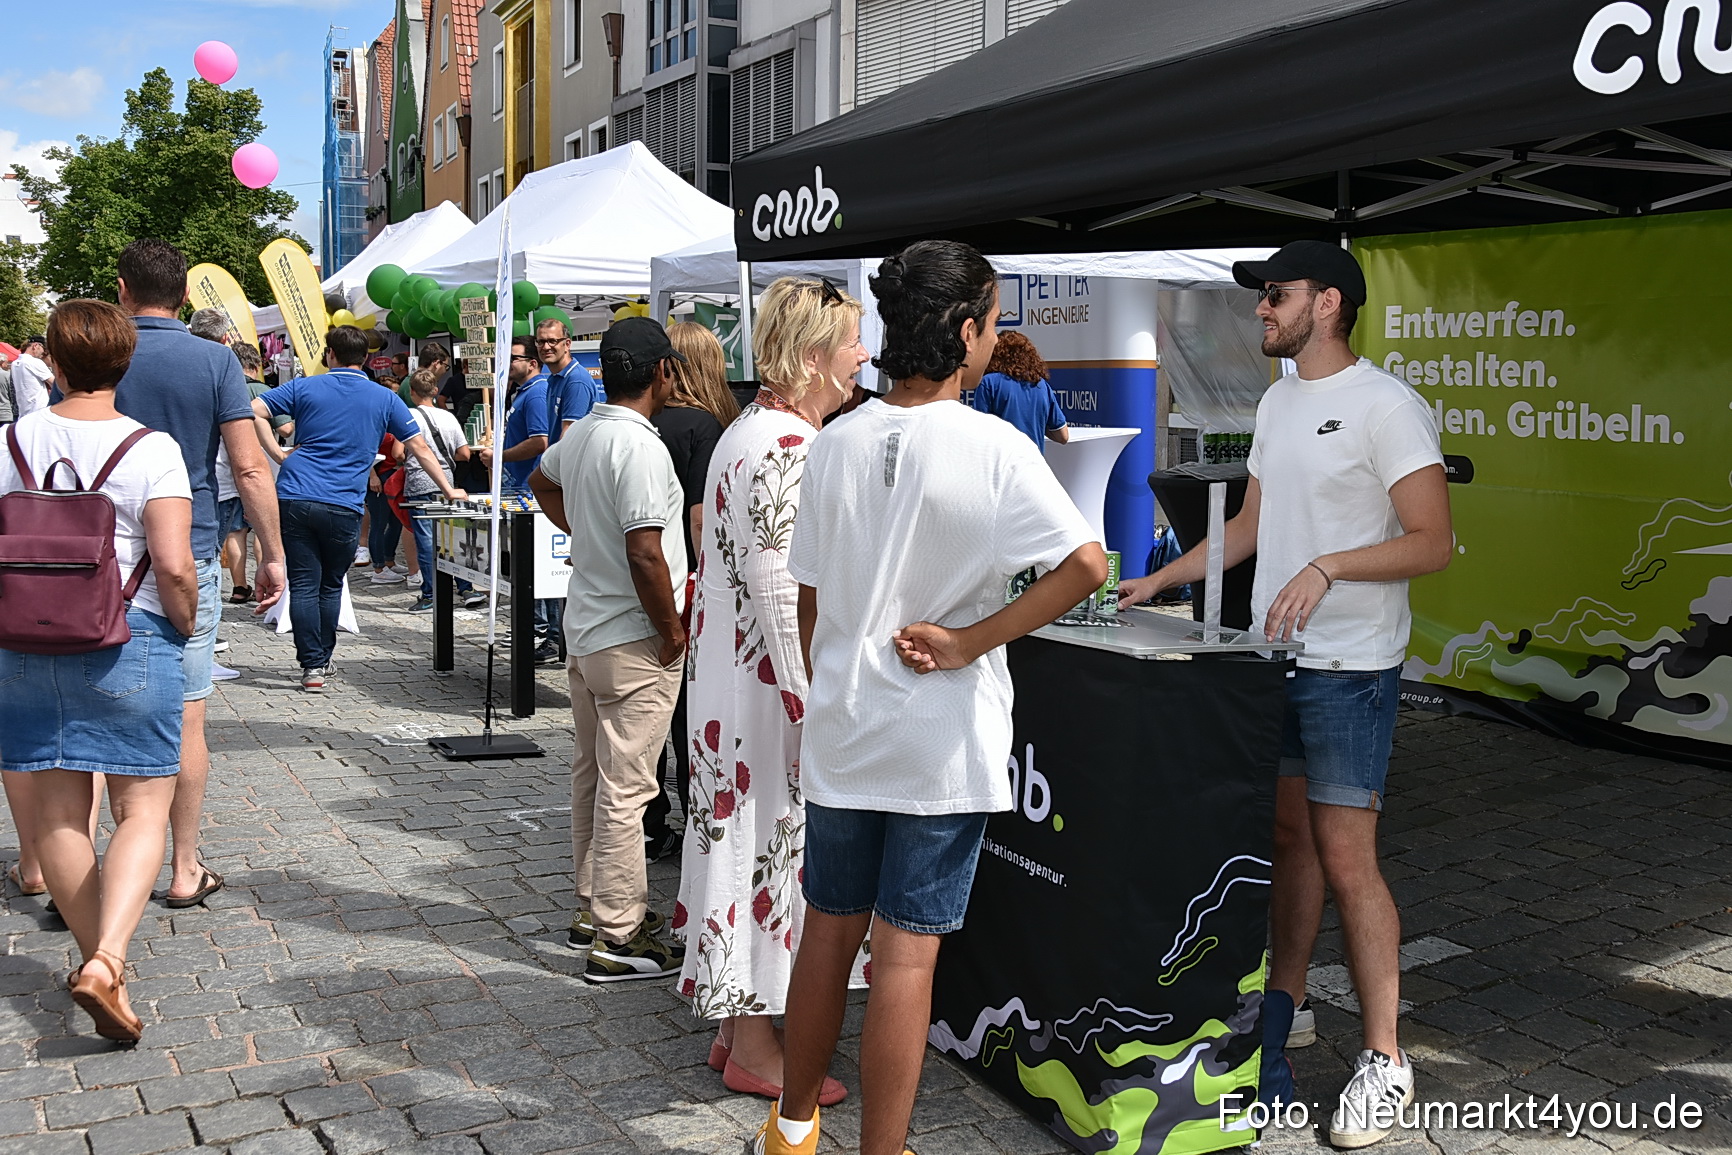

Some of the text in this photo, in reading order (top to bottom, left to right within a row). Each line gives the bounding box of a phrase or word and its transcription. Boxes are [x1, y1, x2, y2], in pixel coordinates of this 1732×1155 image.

[1027, 304, 1090, 326] INGENIEURE
[1384, 300, 1576, 339] Entwerfen.
[1383, 350, 1558, 388] Gestalten.
[1507, 400, 1685, 445] Grübeln.
[982, 837, 1067, 888] nikationsagentur.
